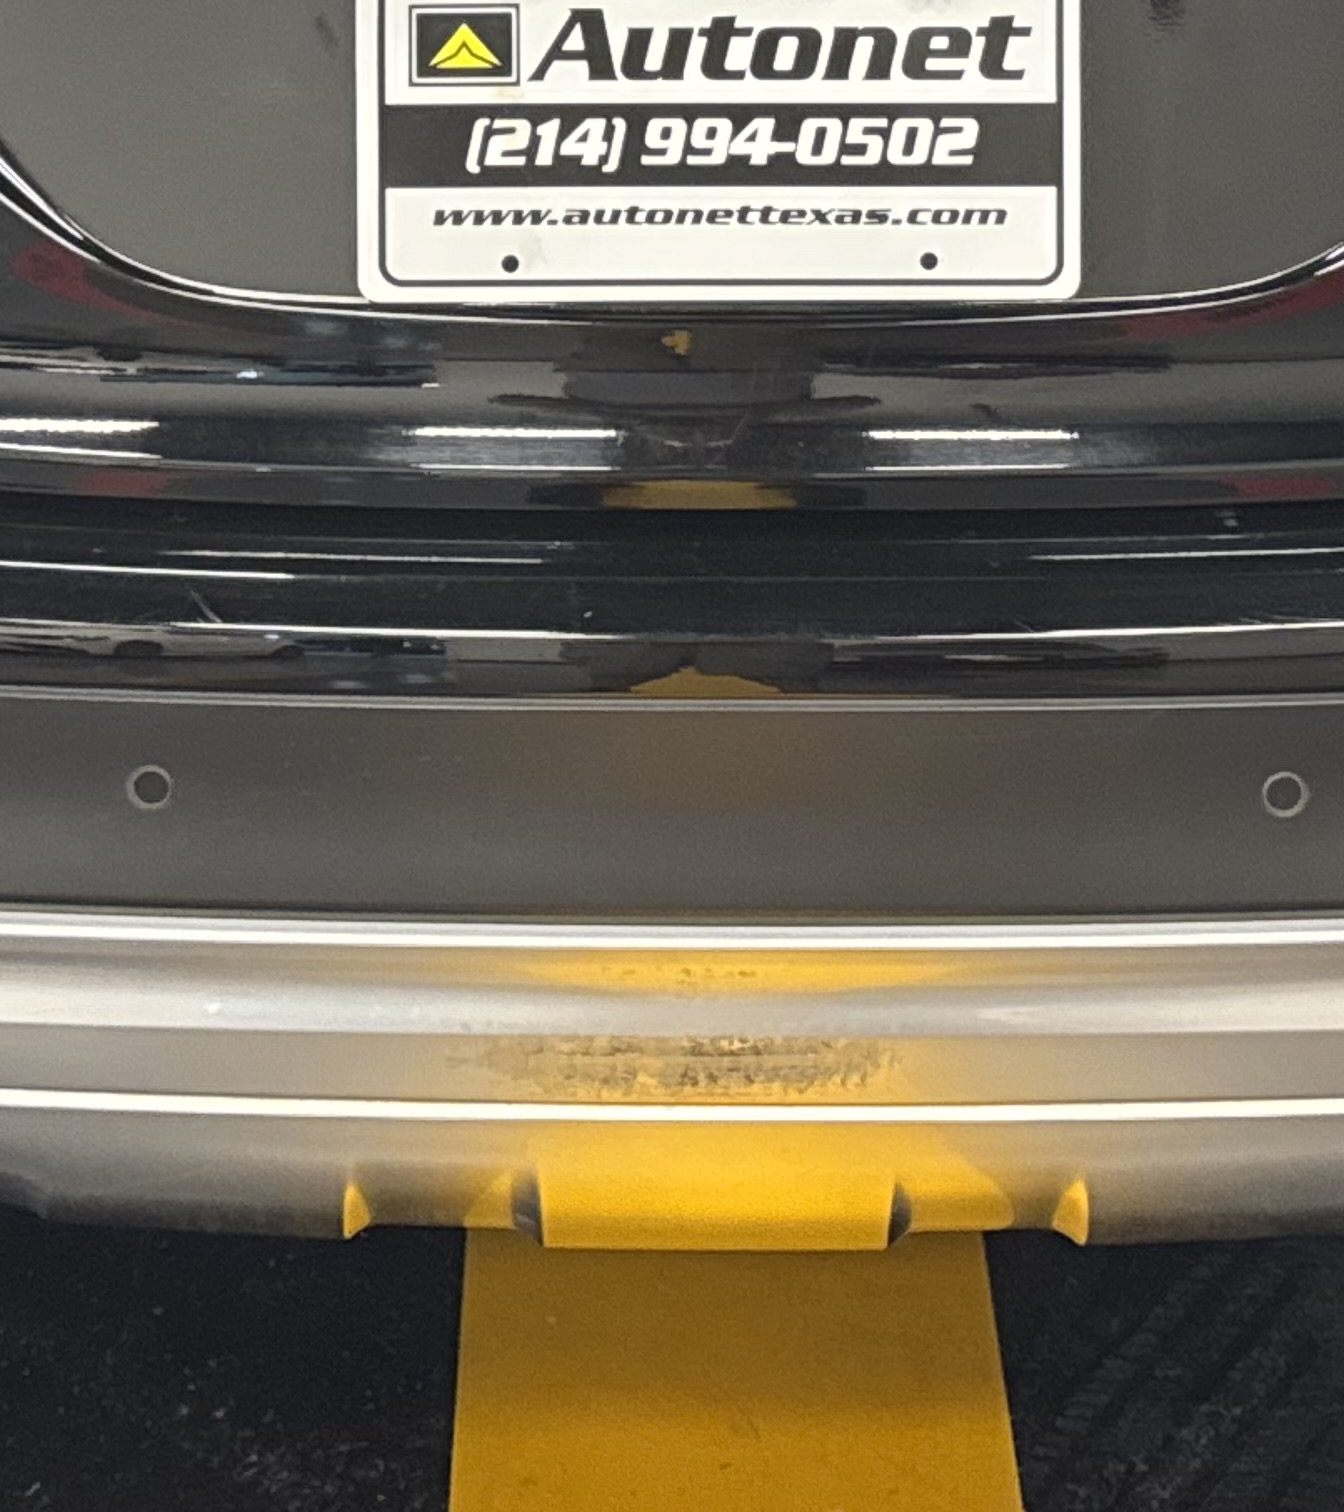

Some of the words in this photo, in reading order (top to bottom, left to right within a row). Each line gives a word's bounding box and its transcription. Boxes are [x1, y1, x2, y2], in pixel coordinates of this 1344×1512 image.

[527, 7, 1033, 82] Autonet
[464, 117, 628, 174] (214)
[640, 117, 980, 168] 994-0502
[432, 203, 1008, 227] www.autonettexas.com
